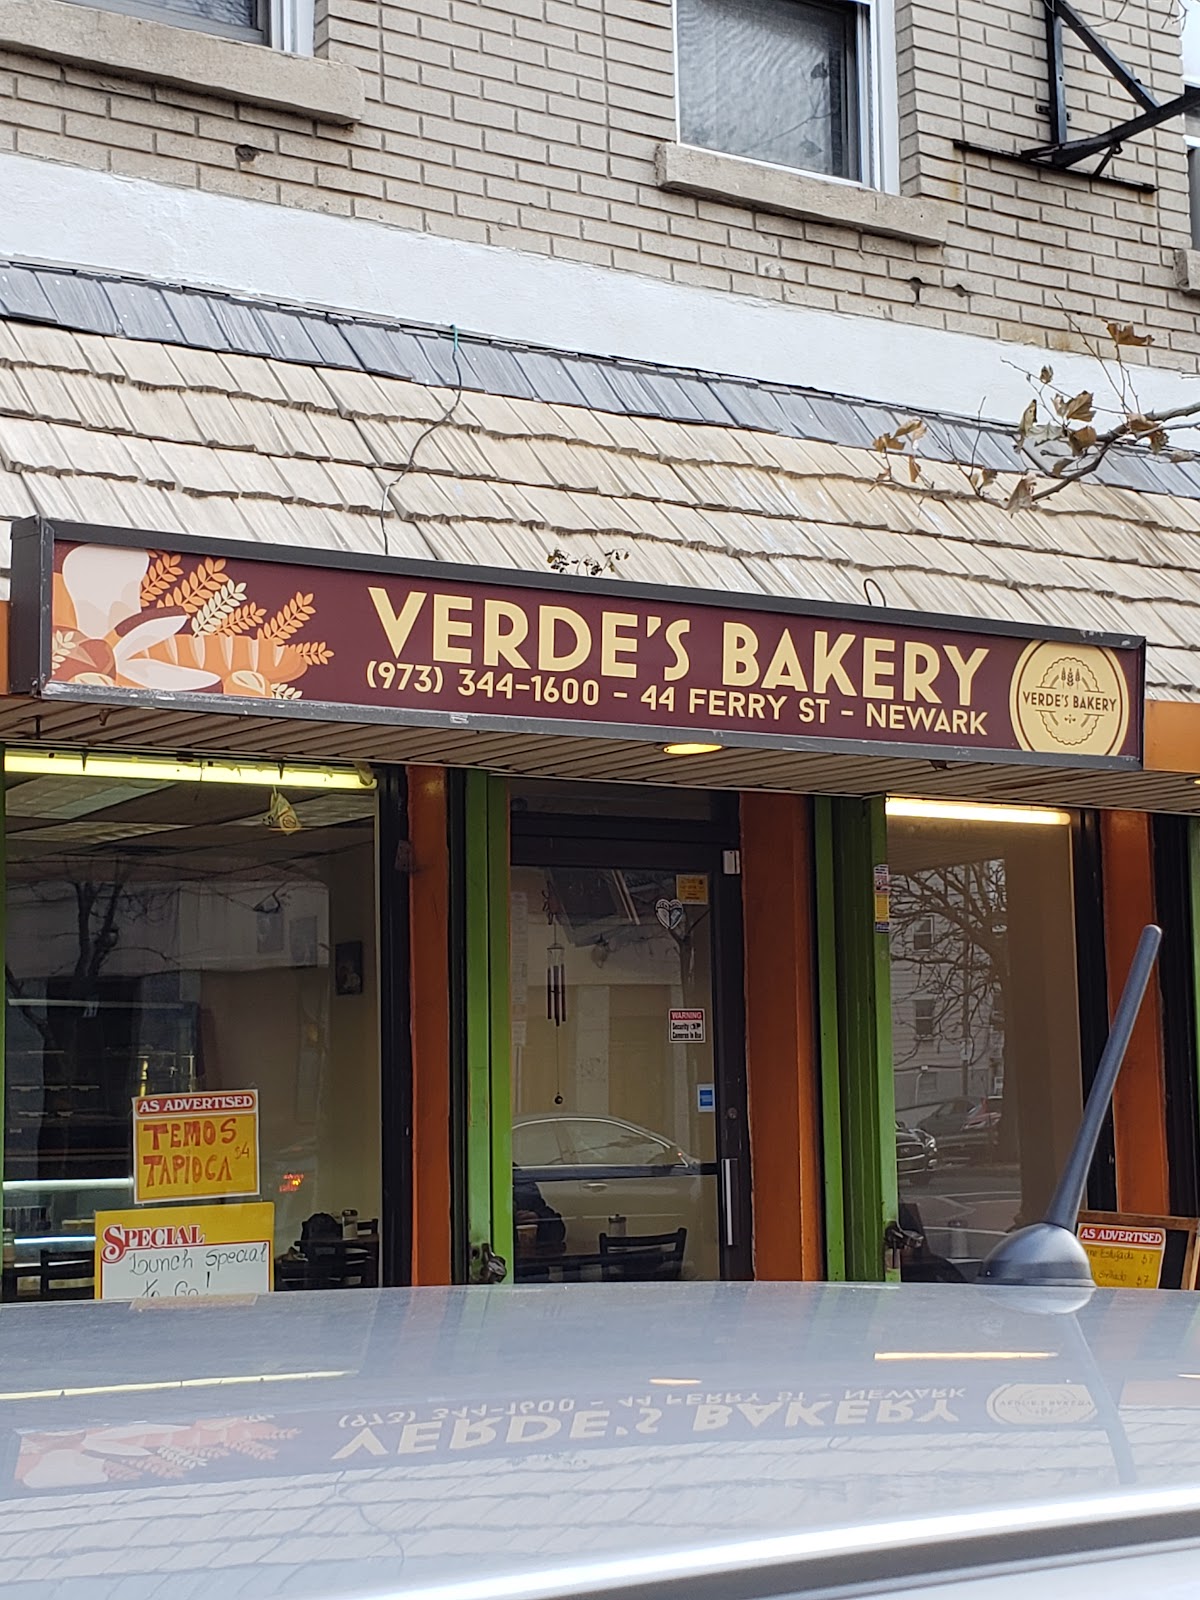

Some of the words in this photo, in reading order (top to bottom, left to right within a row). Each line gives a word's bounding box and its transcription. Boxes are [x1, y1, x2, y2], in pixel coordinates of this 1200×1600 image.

[368, 586, 690, 682] VERDE'S
[722, 621, 990, 706] BAKERY
[366, 661, 443, 693] (973)
[458, 668, 599, 705] 344-1600
[640, 685, 675, 712] 44
[689, 688, 788, 720] FERRY
[799, 697, 830, 724] ST
[866, 702, 988, 736] NEWARK
[1022, 691, 1069, 708] VERDE'S
[1073, 695, 1117, 712] BAKERY
[671, 1011, 702, 1020] WARNING
[139, 1099, 160, 1113] AS
[163, 1095, 253, 1112] ADVERTISED
[143, 1118, 237, 1150] TEMOS
[143, 1154, 232, 1187] TAPIOCA
[102, 1225, 204, 1262] SPECIAL
[1080, 1228, 1096, 1239] AS
[1097, 1229, 1162, 1244] ADVERTISED
[130, 1249, 193, 1275] Lunch
